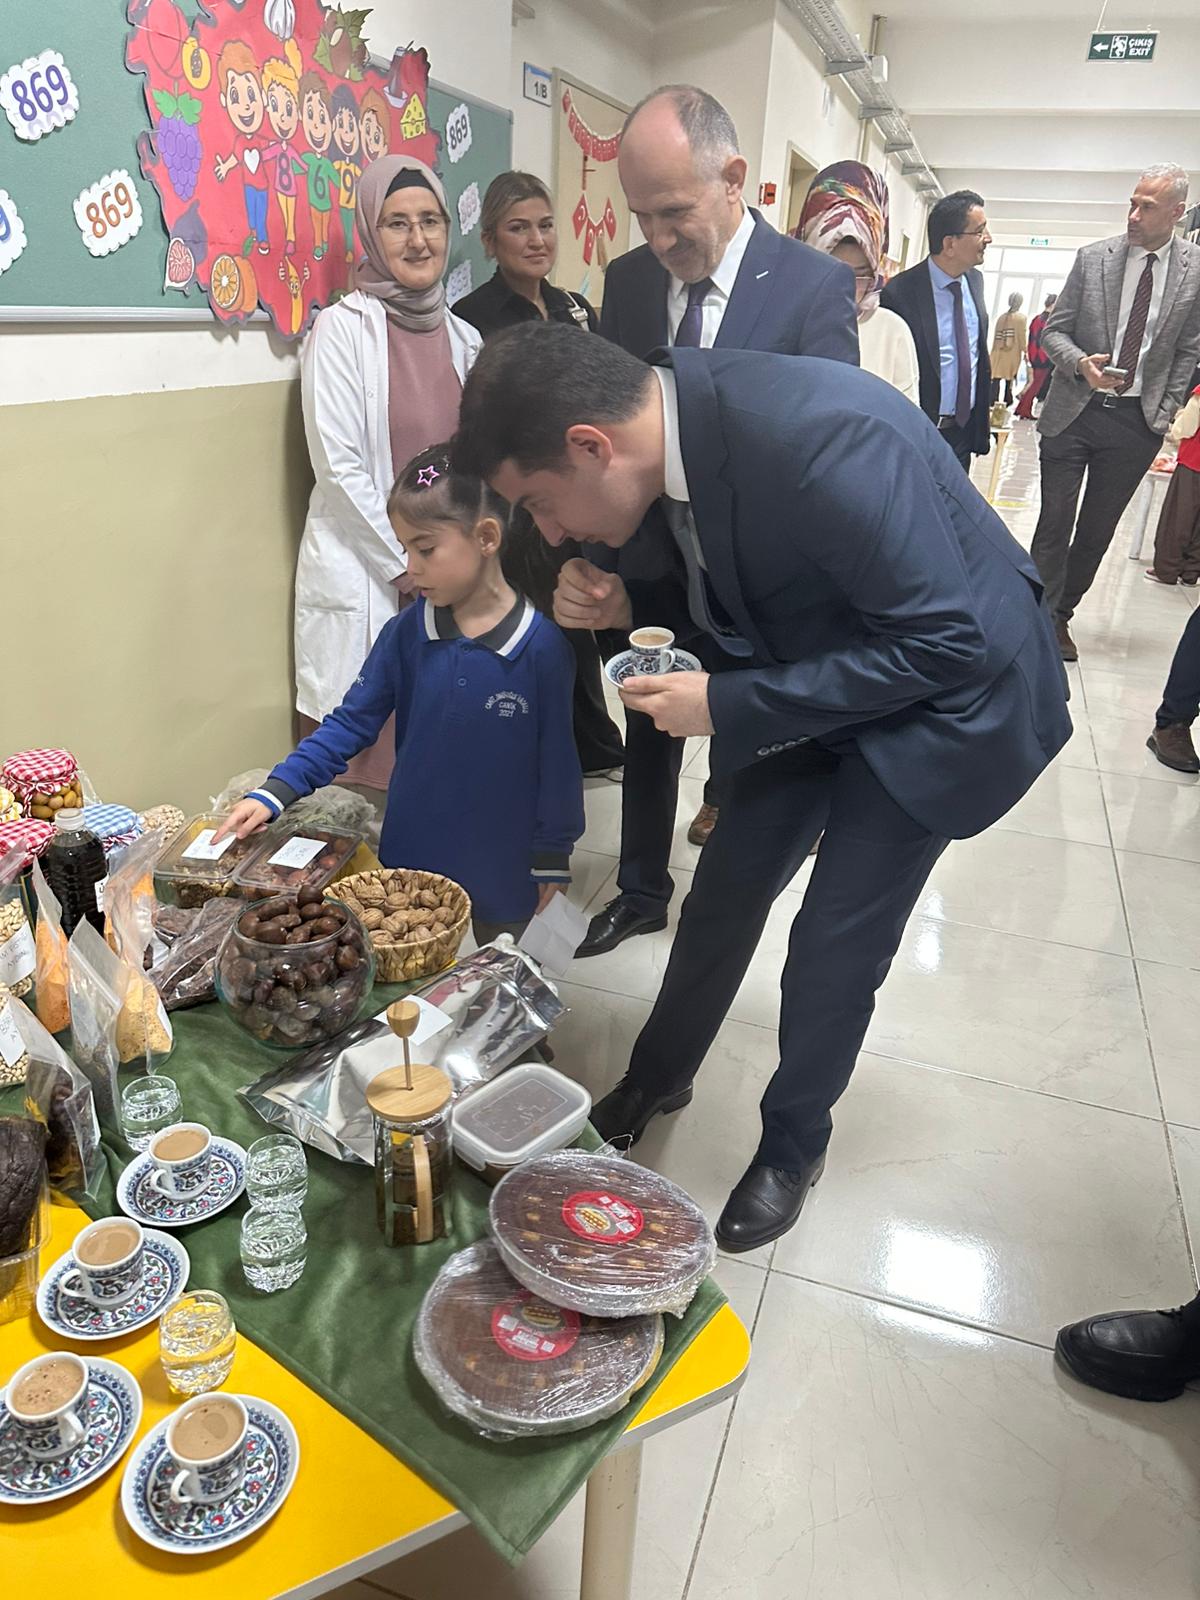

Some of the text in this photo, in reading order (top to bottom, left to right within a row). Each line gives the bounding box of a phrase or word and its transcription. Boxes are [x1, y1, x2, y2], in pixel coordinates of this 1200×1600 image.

[1128, 38, 1153, 48] ÇIKIŞ
[1128, 47, 1150, 56] EXIT
[12, 65, 68, 121] 869
[450, 113, 468, 150] 869
[279, 152, 354, 205] 8 6 9
[86, 182, 133, 238] 869
